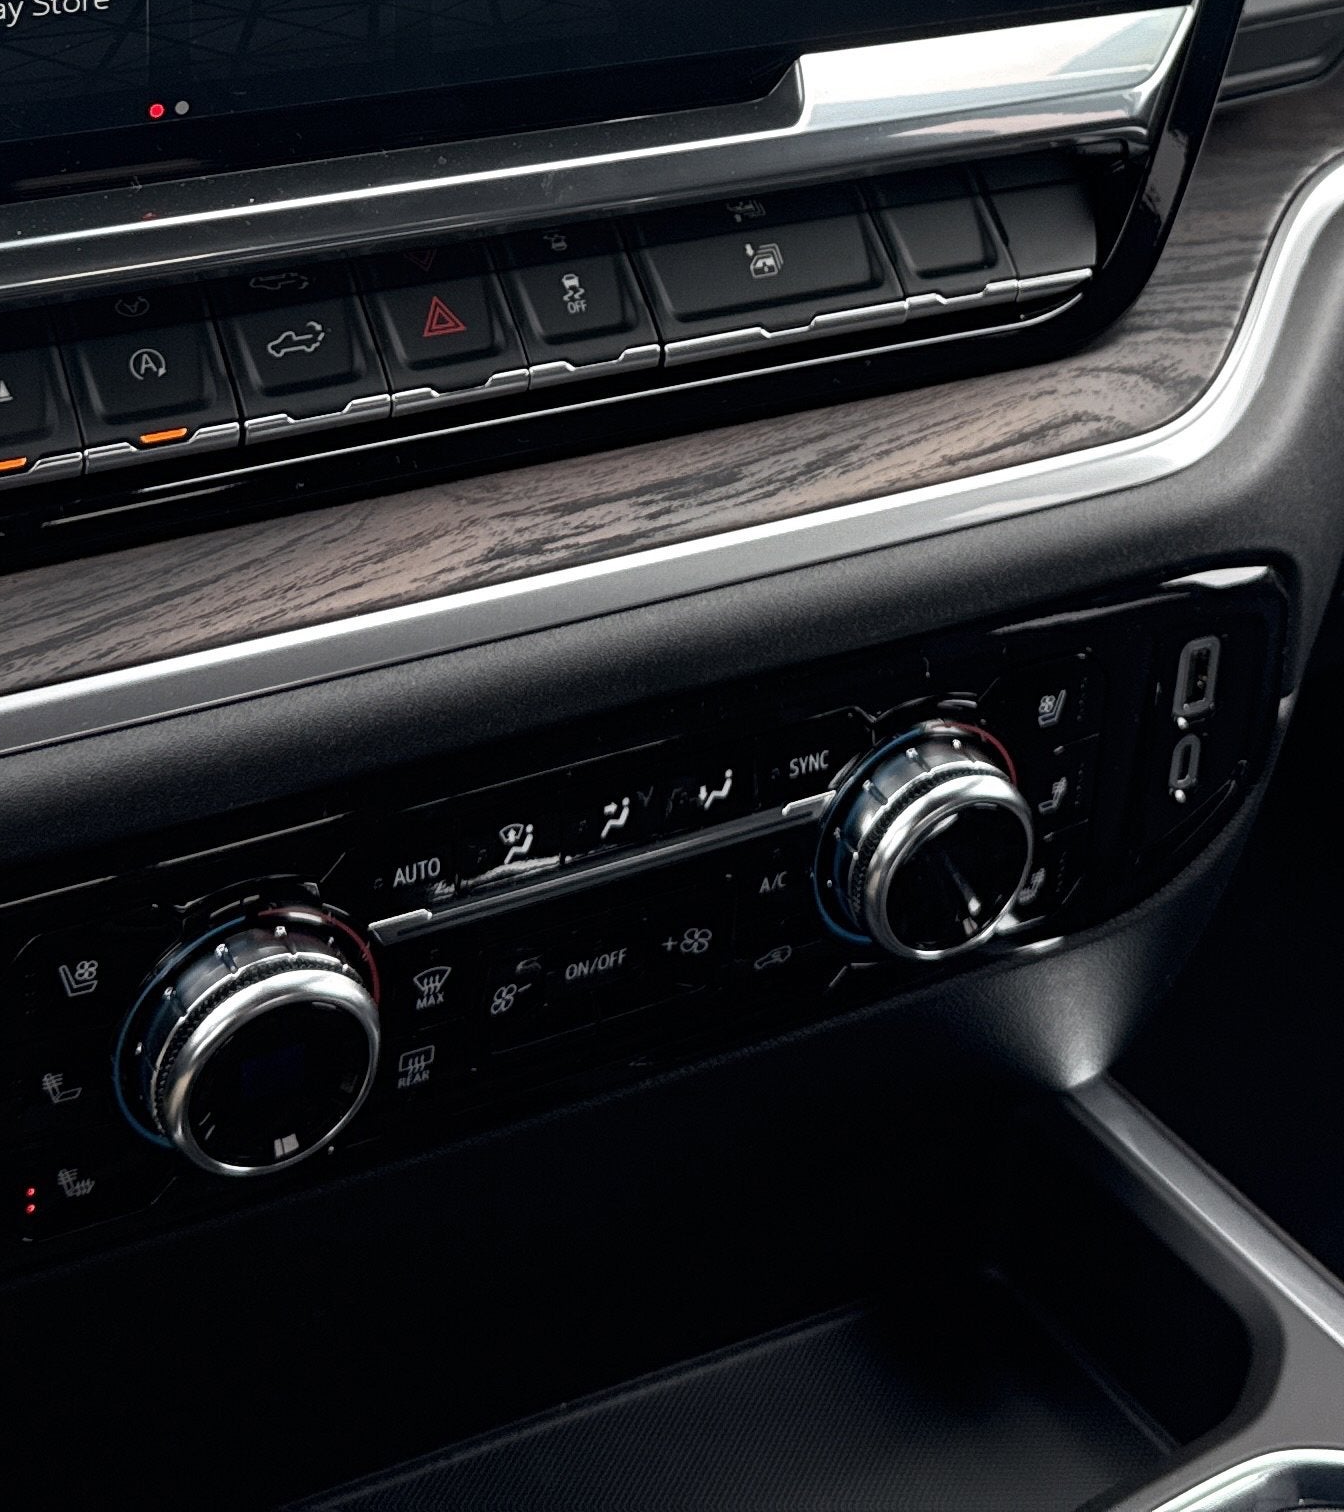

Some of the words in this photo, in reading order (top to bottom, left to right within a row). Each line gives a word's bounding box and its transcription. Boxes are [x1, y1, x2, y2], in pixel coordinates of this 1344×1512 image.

[566, 297, 588, 315] OFF
[788, 749, 830, 779] SYNC
[393, 857, 441, 886] AUTO
[759, 871, 787, 894] A/C
[565, 948, 627, 980] ON/OFF
[415, 991, 445, 1011] MAX
[397, 1069, 431, 1089] REAR
